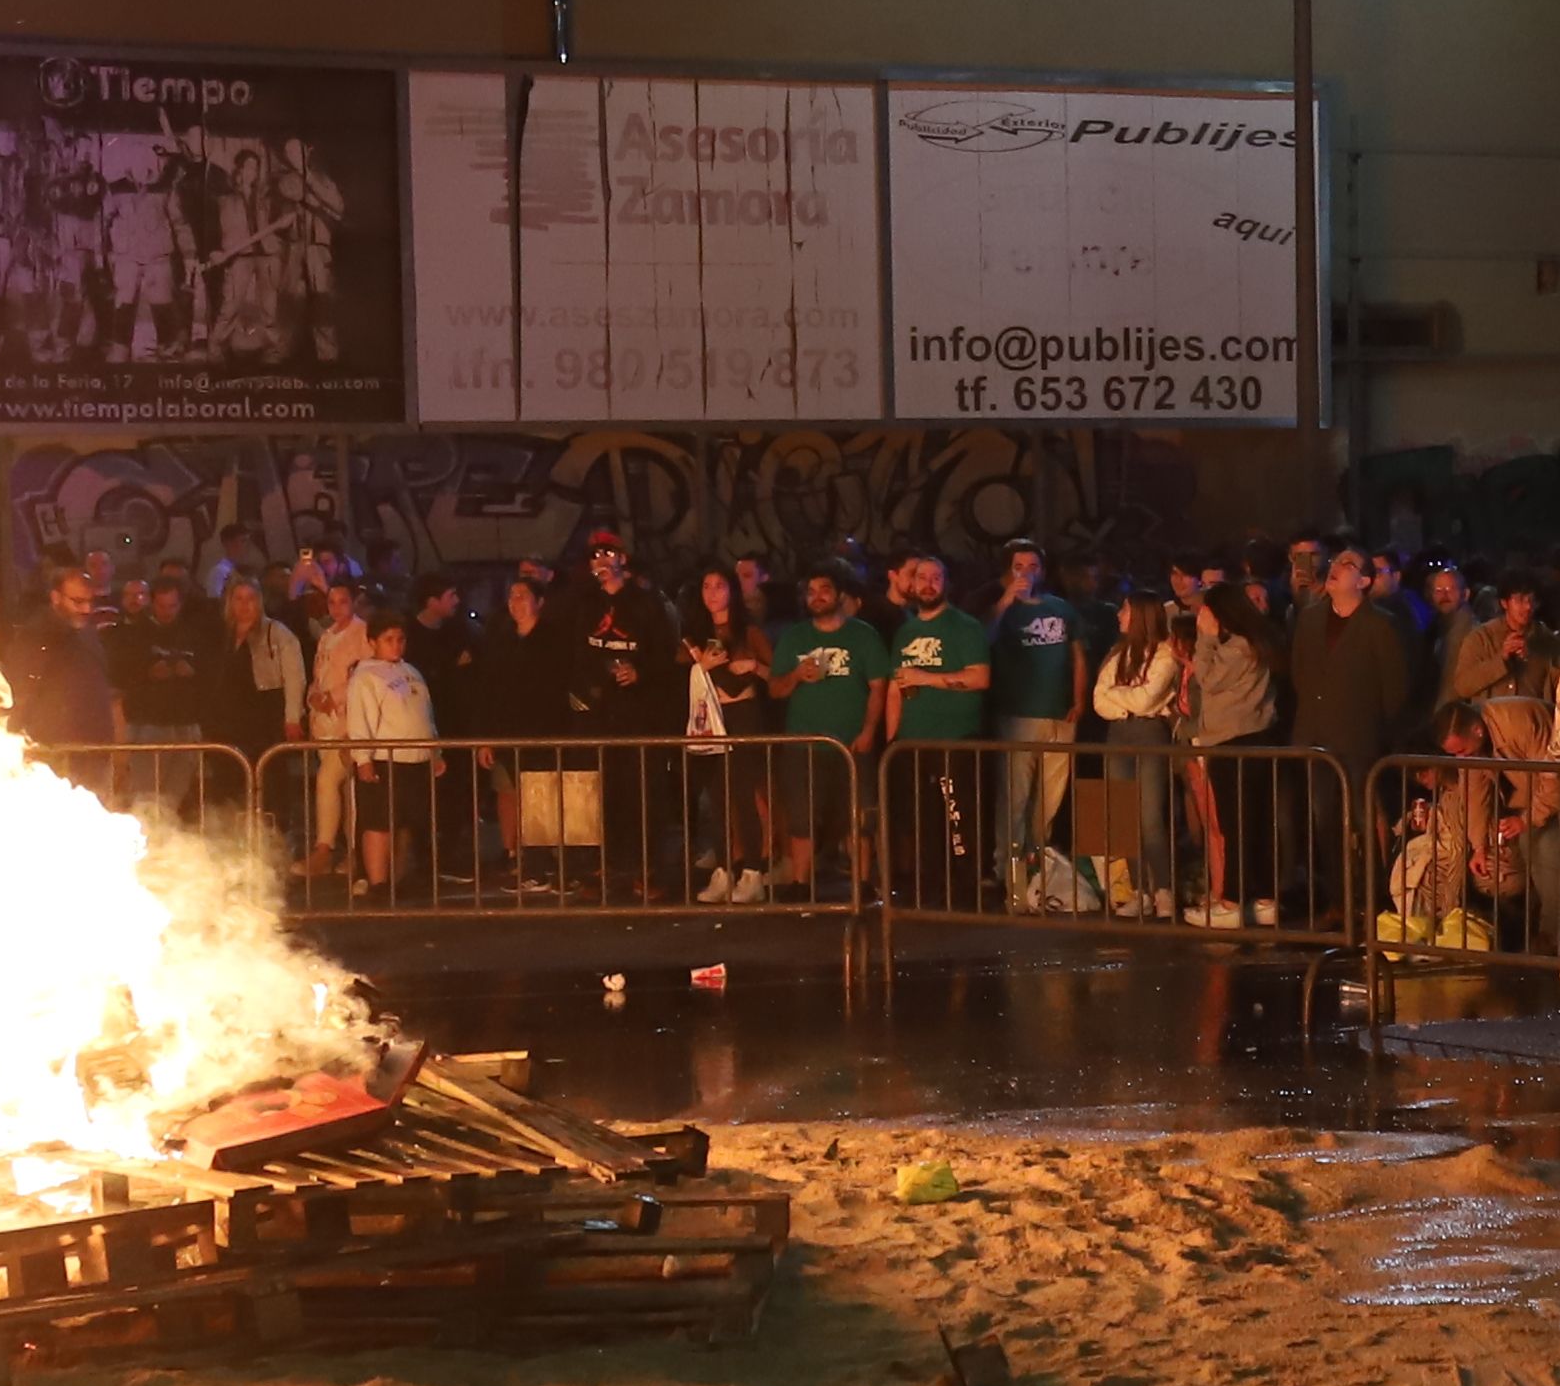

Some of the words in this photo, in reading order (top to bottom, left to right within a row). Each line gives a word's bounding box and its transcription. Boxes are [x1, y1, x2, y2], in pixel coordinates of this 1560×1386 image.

[89, 66, 252, 113] Tiempo
[1069, 120, 1297, 152] Publijes
[616, 176, 829, 227] Zamora
[772, 347, 860, 390] 873
[910, 326, 1298, 370] info@publijes.com
[4, 373, 27, 390] de
[32, 373, 49, 390] la
[955, 379, 997, 411] tf.
[1013, 376, 1088, 411] 653
[1103, 376, 1176, 411] 672
[1190, 376, 1263, 411] 430
